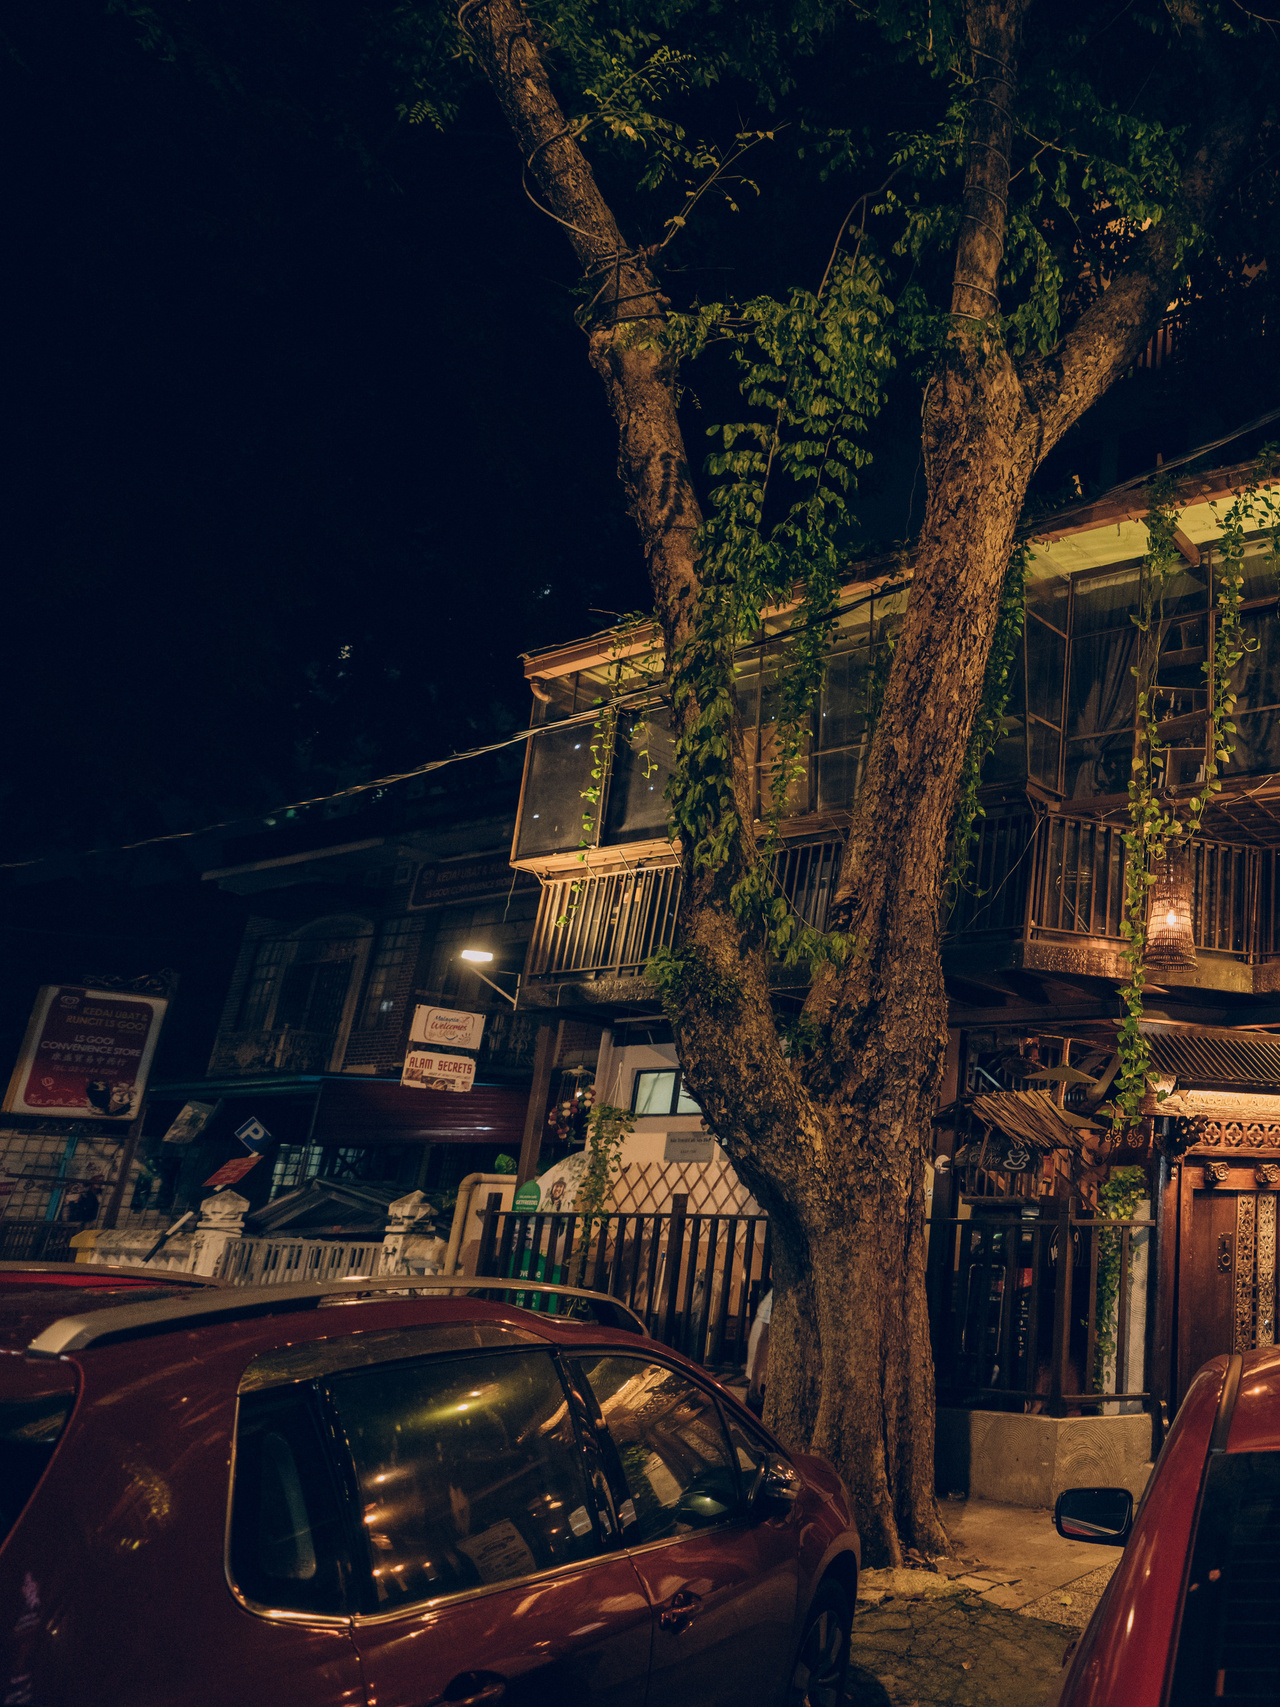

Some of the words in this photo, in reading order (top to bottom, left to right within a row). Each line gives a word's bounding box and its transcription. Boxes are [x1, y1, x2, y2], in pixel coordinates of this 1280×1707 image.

[83, 1007, 113, 1018] KEDAI
[115, 1011, 141, 1020] UBAT
[435, 1015, 460, 1023] Malaysia
[65, 1015, 104, 1026] RUNCIT
[105, 1019, 115, 1028] LS
[117, 1020, 147, 1031] GOOI
[430, 1021, 467, 1031] Welcomes
[74, 1034, 86, 1043] LS
[86, 1035, 115, 1045] GOOI
[438, 1030, 457, 1038] You
[41, 1040, 113, 1054] CONVENIENCE
[113, 1047, 142, 1057] STORE
[409, 1056, 434, 1070] ALAM
[437, 1060, 473, 1075] SECRETS
[239, 1121, 265, 1140] P
